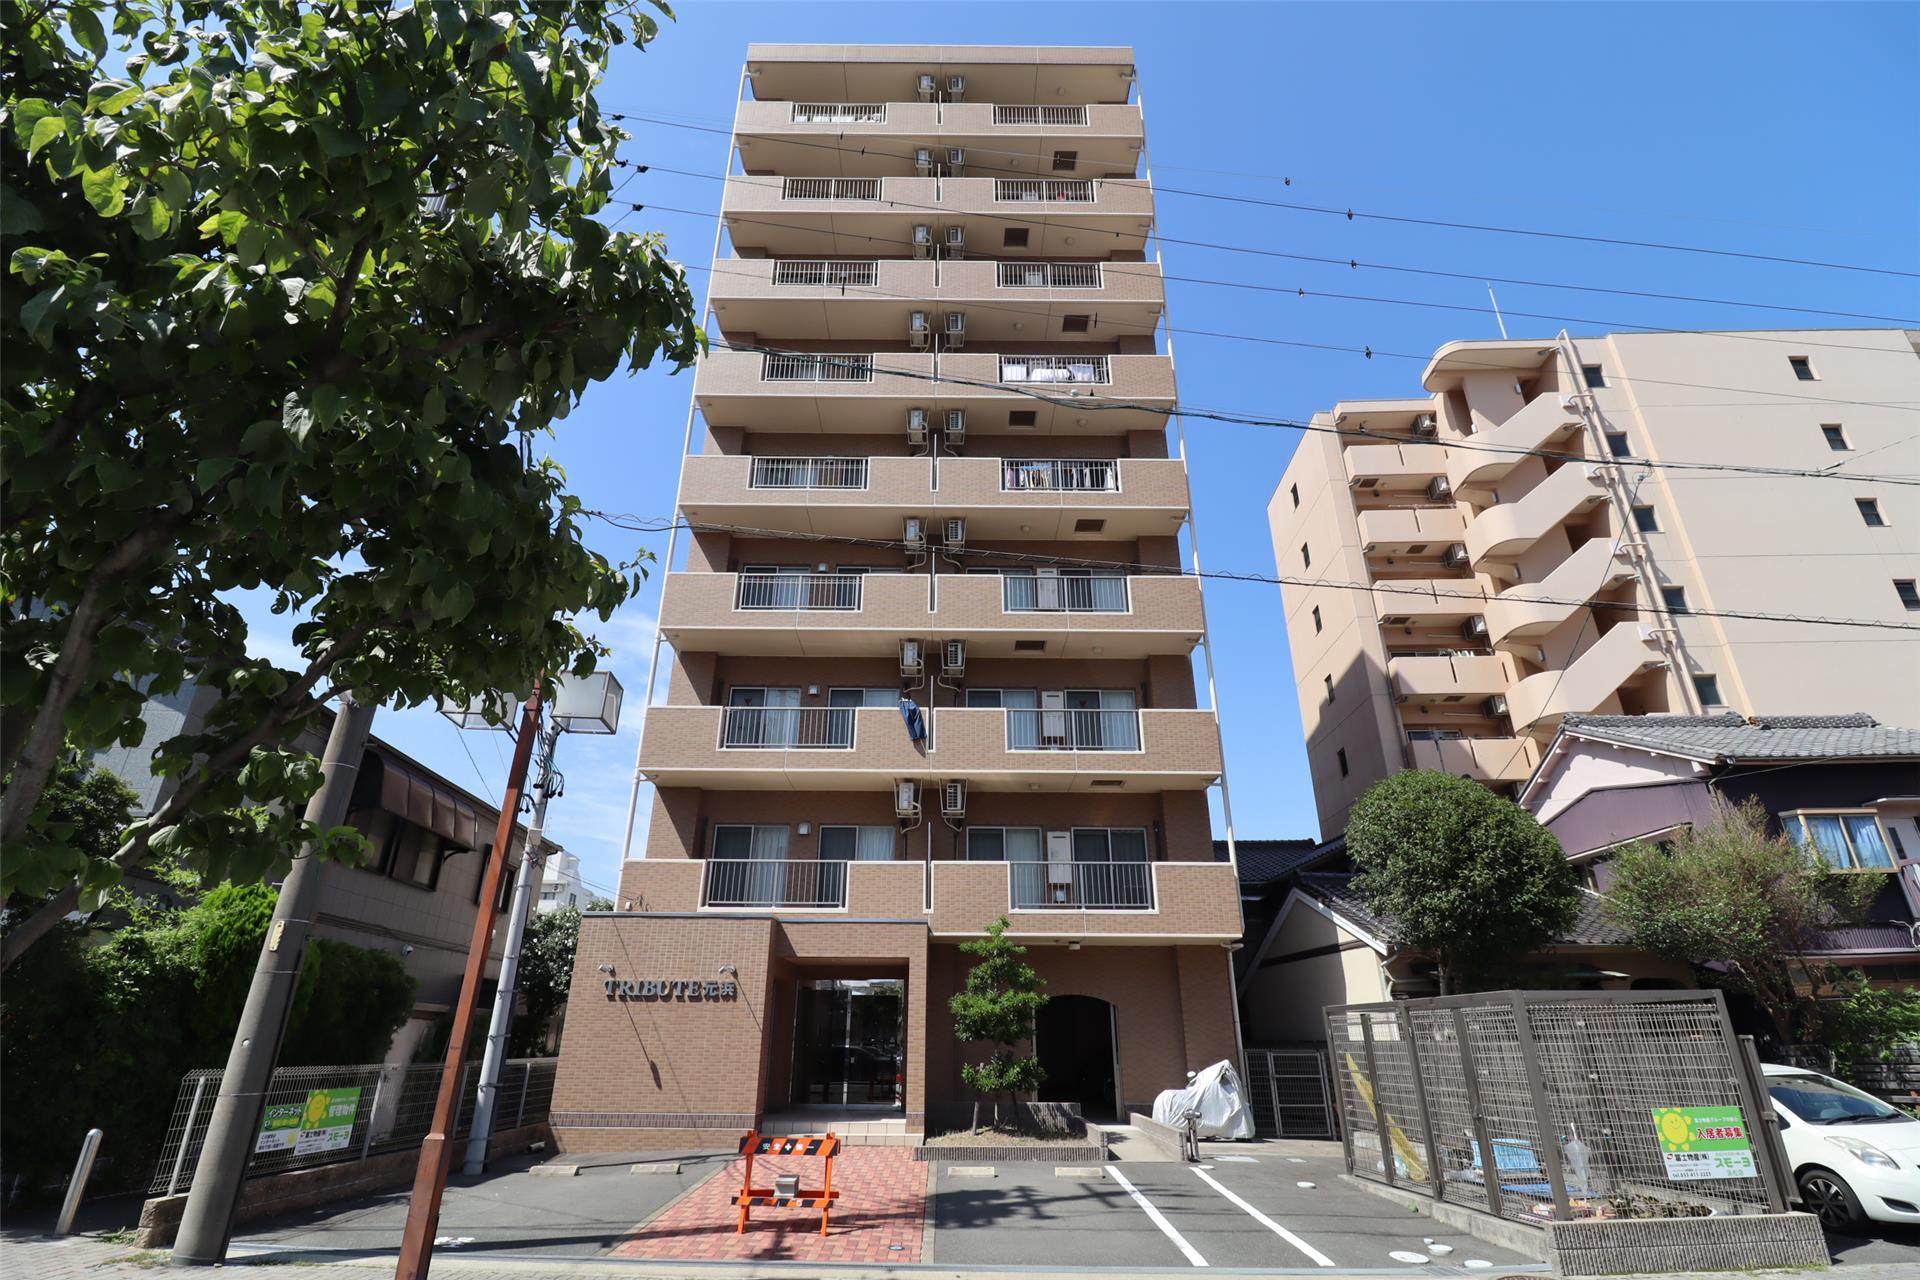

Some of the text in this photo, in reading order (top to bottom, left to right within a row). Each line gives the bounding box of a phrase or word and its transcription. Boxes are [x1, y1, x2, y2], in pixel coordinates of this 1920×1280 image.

[268, 1107, 302, 1118] インターネット
[1697, 1126, 1744, 1139] 入居者募集
